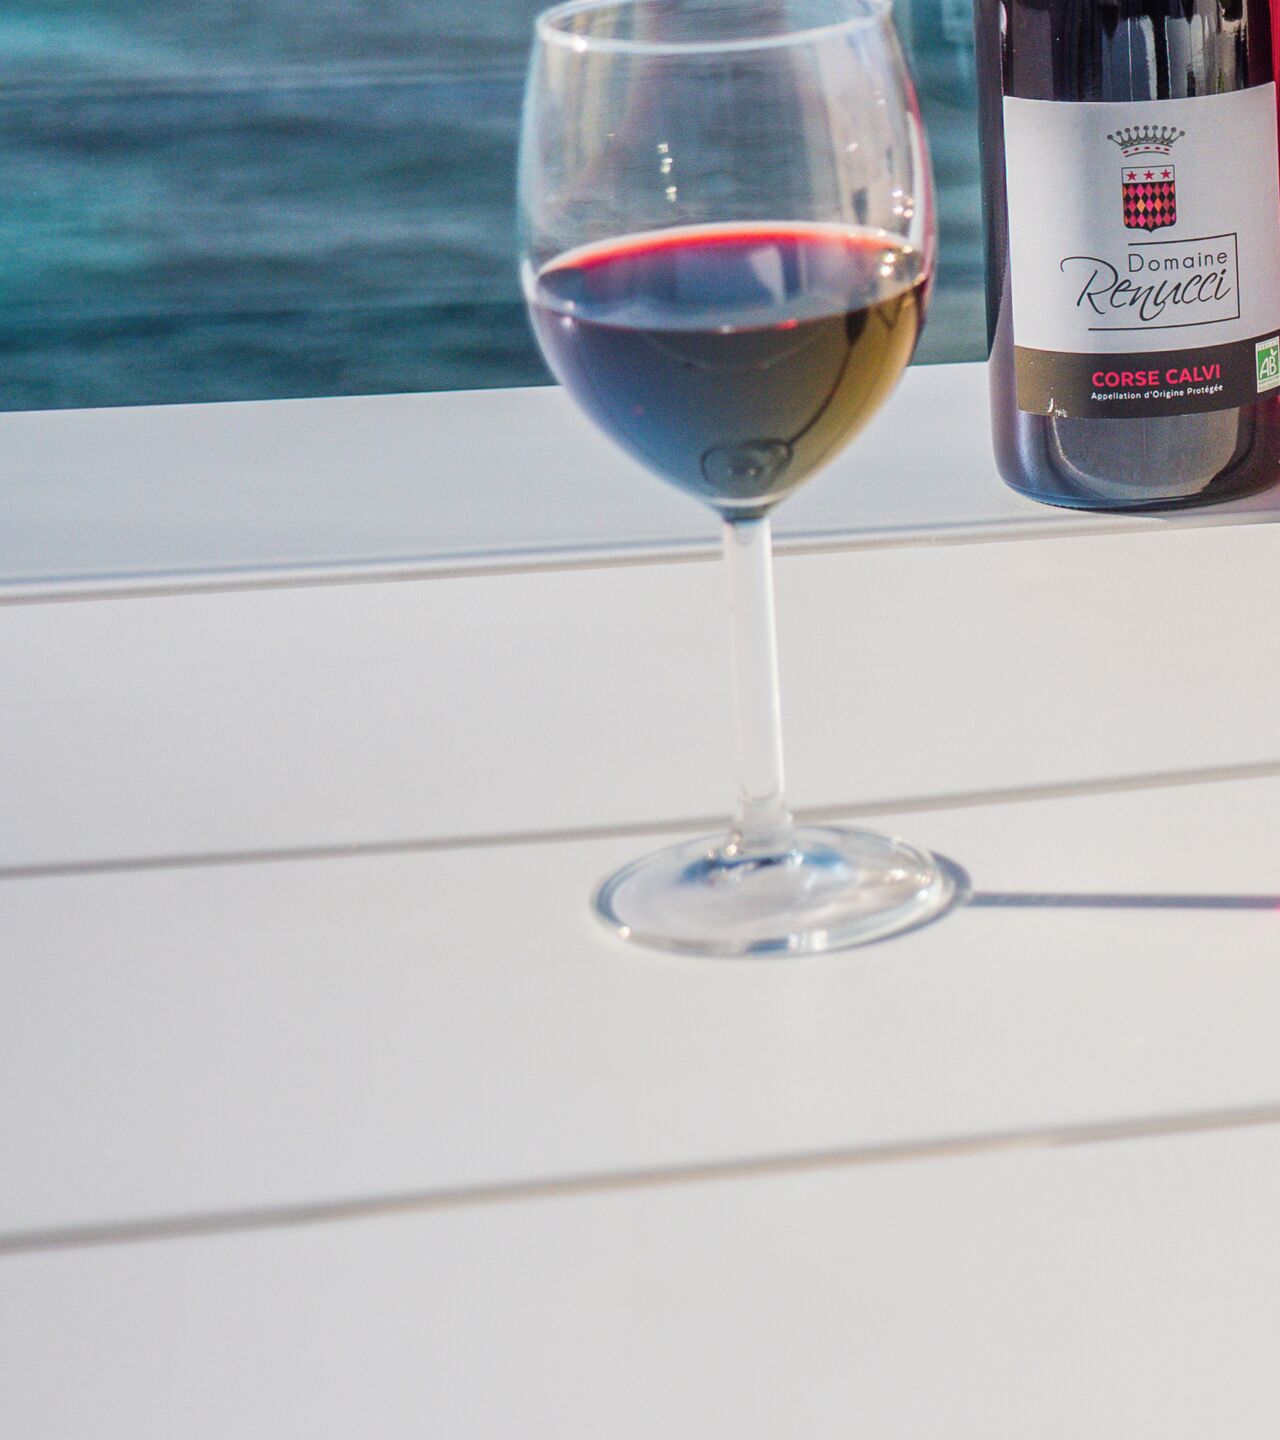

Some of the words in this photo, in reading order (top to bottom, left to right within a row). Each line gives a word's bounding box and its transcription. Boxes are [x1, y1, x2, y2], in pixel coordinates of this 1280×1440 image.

[1128, 252, 1228, 273] Domaine
[1060, 256, 1232, 322] Renucci
[1091, 371, 1160, 387] CORSE
[1165, 364, 1221, 384] CALVI
[1090, 391, 1142, 403] Appellation
[1186, 383, 1224, 396] Protégée
